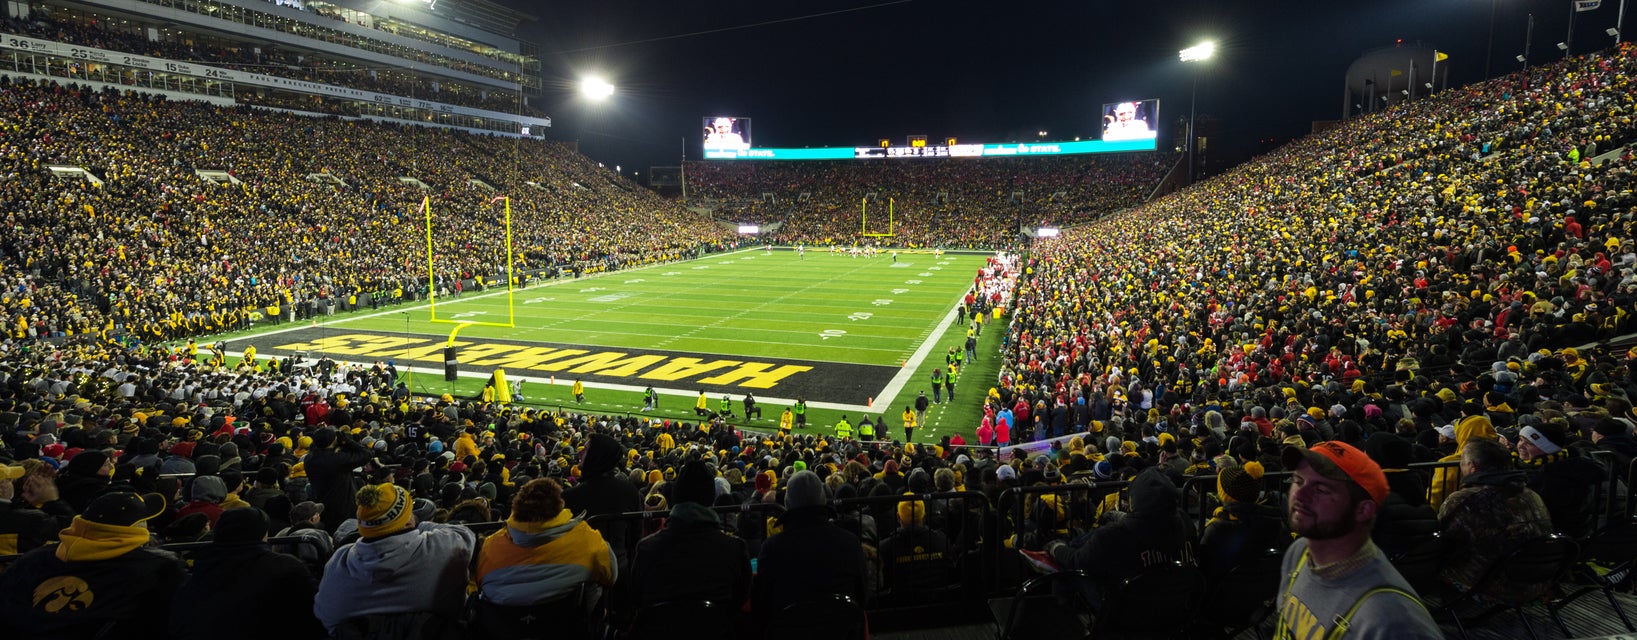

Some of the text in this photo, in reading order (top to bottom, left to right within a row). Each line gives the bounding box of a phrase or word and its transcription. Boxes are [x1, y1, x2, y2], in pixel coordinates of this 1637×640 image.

[10, 39, 29, 49] 36
[71, 48, 88, 59] 25
[123, 56, 131, 65] 2
[165, 63, 177, 71] 15
[205, 69, 218, 77] 24
[273, 334, 814, 389] HAWKEYES
[408, 426, 418, 438] 15
